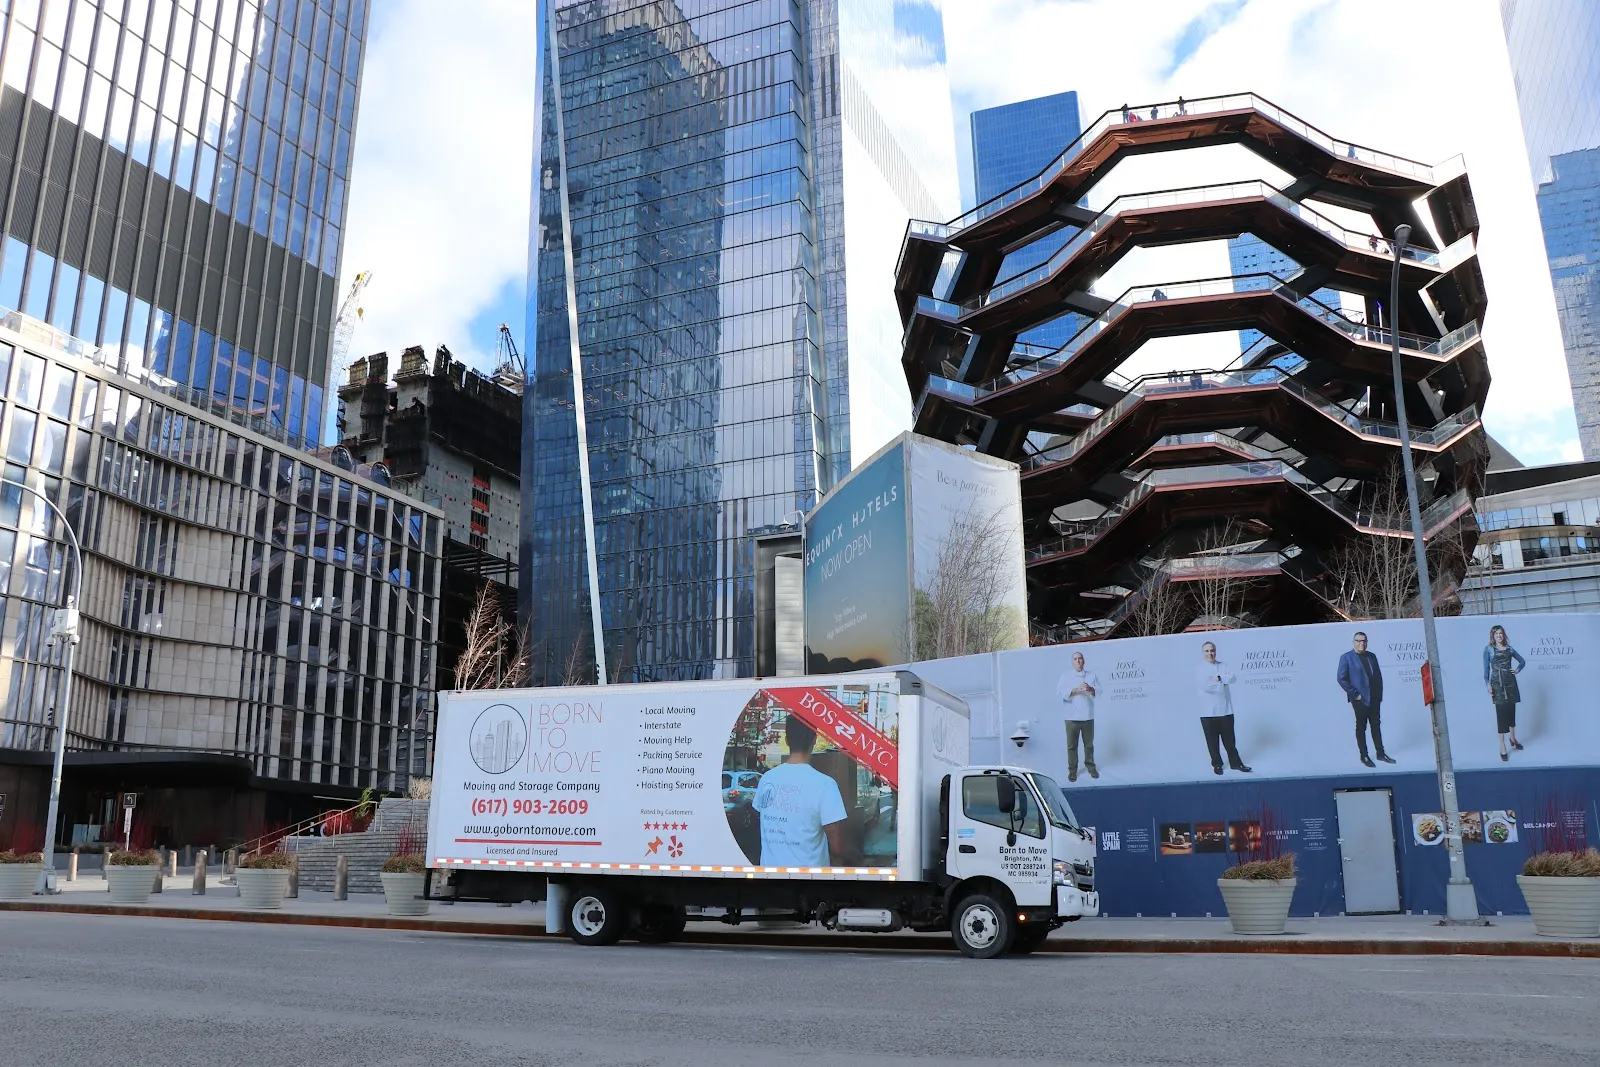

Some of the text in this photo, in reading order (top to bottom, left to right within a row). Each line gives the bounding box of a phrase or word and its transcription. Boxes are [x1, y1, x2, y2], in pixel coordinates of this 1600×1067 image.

[936, 469, 949, 485] Be
[821, 529, 872, 583] NOW OPEN
[1387, 642, 1426, 652] STEPHE
[1539, 637, 1562, 646] ANYA
[1245, 650, 1288, 660] MICHAEL
[1395, 651, 1426, 661] STARR
[1530, 646, 1574, 656] FERNALD
[1240, 659, 1294, 670] LOMONACO
[539, 702, 603, 725] BORN
[645, 705, 696, 716] Local Moving
[644, 721, 682, 730] Interstate
[798, 691, 838, 725] BOS
[853, 732, 893, 767] NYC
[537, 727, 567, 749] TO
[643, 735, 692, 746] Moving Help
[643, 750, 703, 761] Packing Service
[532, 751, 602, 773] MOVE
[642, 765, 695, 776] Piano Moving
[463, 781, 601, 793] Moving and Storage Company
[641, 780, 704, 791] Hoisting Service
[471, 798, 589, 817] (617) 903-2609
[656, 809, 664, 817] by
[463, 823, 597, 837] www.goborntomove.com
[1102, 831, 1120, 841] LITTLE
[486, 846, 558, 856] Licensed and Insured
[999, 846, 1048, 854] Born to Move
[1102, 840, 1121, 851] SPAIN
